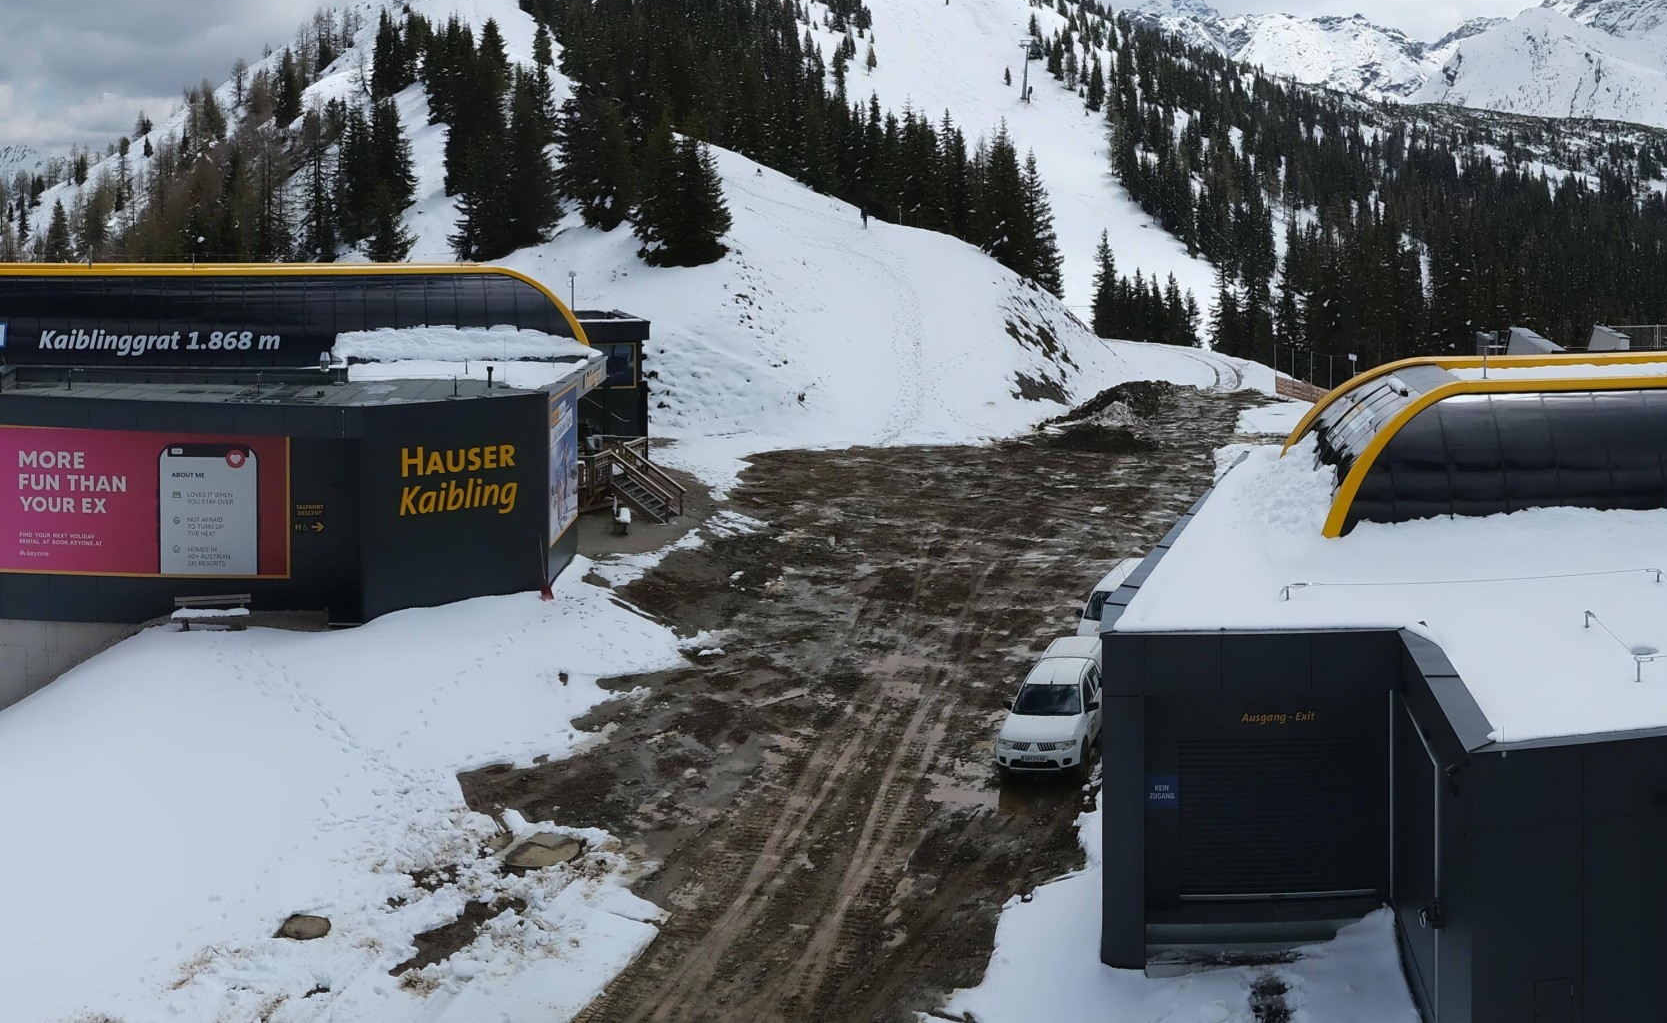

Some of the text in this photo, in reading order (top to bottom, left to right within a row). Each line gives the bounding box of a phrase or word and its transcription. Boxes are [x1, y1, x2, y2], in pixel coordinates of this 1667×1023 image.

[38, 329, 281, 356] Kaiblinggrat 1.868 m
[18, 450, 85, 469] MORE
[401, 444, 516, 478] HAUSER
[18, 473, 127, 492] FUN THAN
[19, 496, 107, 514] YOUR EX
[400, 478, 518, 516] Kaibling
[52, 539, 103, 547] BOOK.KEYONE.AT
[26, 550, 50, 558] keyone
[1241, 712, 1287, 725] Ausgang
[1295, 710, 1315, 721] Exit
[1149, 792, 1175, 800] ZUGANG
[1154, 784, 1169, 792] KEIN
